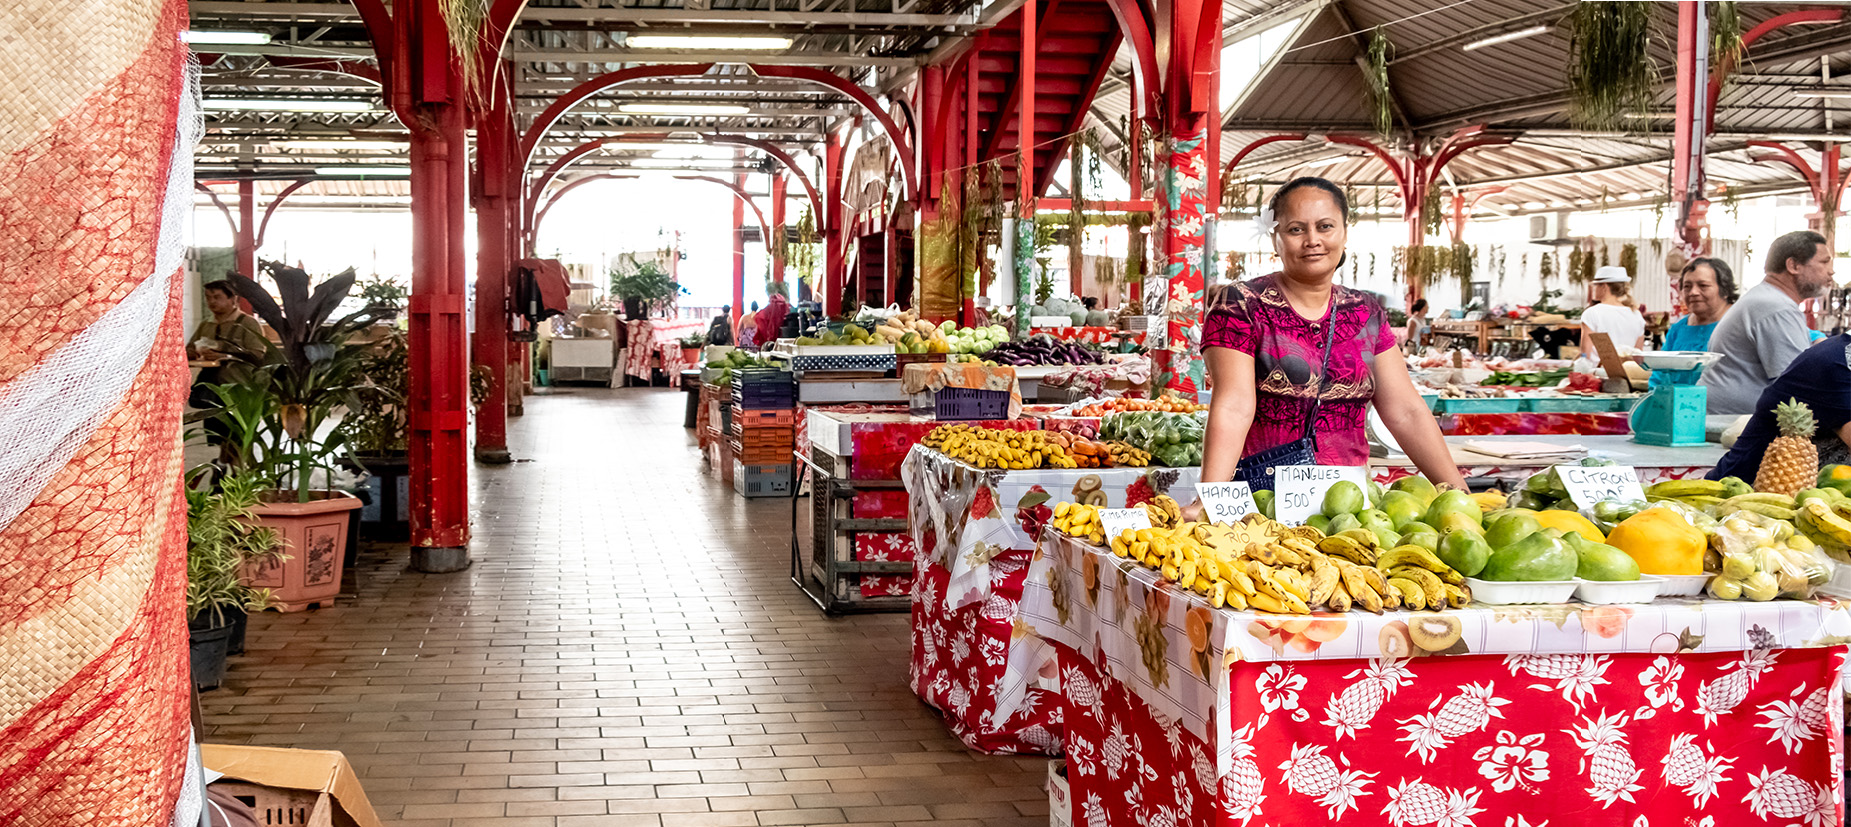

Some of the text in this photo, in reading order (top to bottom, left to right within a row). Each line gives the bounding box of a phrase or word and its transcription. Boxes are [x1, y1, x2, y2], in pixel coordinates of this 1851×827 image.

[1281, 467, 1340, 481] MANGUES
[1202, 486, 1249, 499] HAMOA
[1224, 532, 1250, 543] RIO
